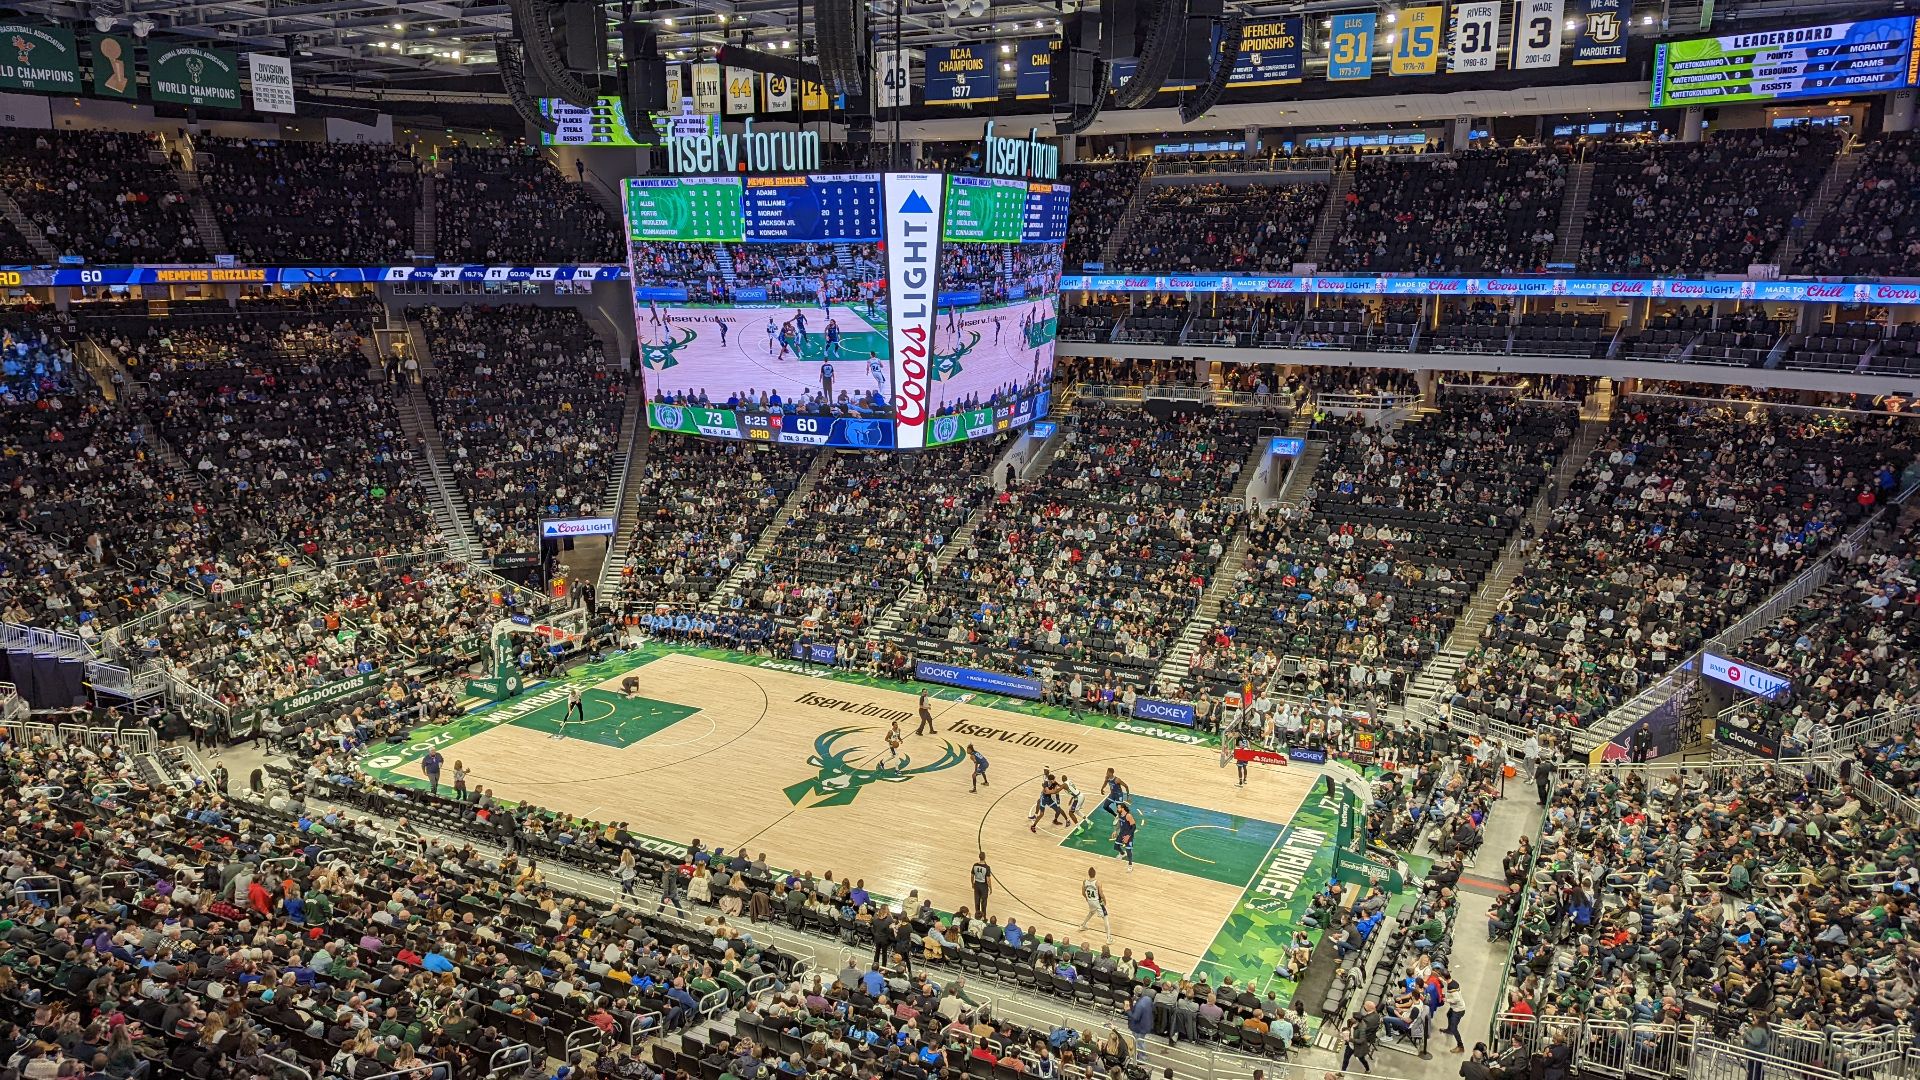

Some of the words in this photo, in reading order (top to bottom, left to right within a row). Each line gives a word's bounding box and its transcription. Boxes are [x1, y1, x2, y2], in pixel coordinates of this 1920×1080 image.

[1532, 3, 1552, 13] WADE
[1590, 0, 1602, 9] WE
[1603, 0, 1619, 8] ARE
[1412, 12, 1425, 21] LEE
[1467, 8, 1492, 18] RIVERS
[1344, 19, 1362, 28] ELLIS
[1461, 22, 1492, 53] 31
[1528, 17, 1551, 48] 3
[1734, 27, 1832, 48] LEADERBOARD
[33, 29, 67, 53] ASSOCIATION
[1398, 26, 1433, 58] 15
[950, 48, 972, 59] NCAA
[1335, 32, 1367, 64] 31
[1580, 45, 1621, 56] MARQUETTE
[1850, 42, 1890, 53] MORANT
[177, 48, 203, 57] BASKETBALL
[203, 51, 230, 73] ASSOCIATION
[1525, 54, 1551, 63] 2001-03
[1767, 51, 1793, 60] POINTS
[258, 63, 284, 73] DIVISION
[939, 59, 983, 72] CHAMPIONS
[1851, 59, 1884, 68] ADAMS
[17, 66, 74, 83] CHAMPIONS
[1759, 66, 1797, 76] REBOUNDS
[255, 72, 290, 85] CHAMPIONS
[1846, 74, 1885, 84] MORANT
[157, 81, 187, 94] WORLD
[189, 85, 236, 100] CHAMPIONS
[696, 81, 717, 96] HANK
[729, 77, 751, 98] 44
[772, 79, 785, 93] 24
[951, 86, 971, 98] 1977
[1761, 82, 1791, 91] ASSISTS
[666, 117, 819, 173] fiserv.forum
[985, 120, 1058, 180] fiserv.forum
[759, 219, 785, 227] JACKSON
[157, 270, 208, 281] MEMPHIS
[211, 269, 265, 281] GRIZZLIES
[392, 270, 404, 278] FG
[440, 270, 455, 278] 3PT
[491, 270, 502, 278] FT
[536, 270, 551, 278] FLS
[903, 219, 928, 319] LIGHT
[81, 270, 102, 282] 60
[1124, 278, 1149, 288] Chill
[1169, 277, 1194, 288] Coors
[1267, 279, 1293, 289] Chill
[1317, 279, 1345, 289] Coors
[1428, 280, 1460, 291] Chill
[1487, 280, 1518, 291] Coors
[1611, 281, 1645, 293] Chill
[1671, 281, 1704, 294] Coors
[1806, 285, 1846, 298] Chill
[1877, 286, 1918, 299] Coors
[896, 323, 927, 428] Coors
[1020, 401, 1029, 414] 60
[705, 411, 722, 425] 73
[744, 415, 768, 426] 8:25
[974, 412, 985, 426] 73
[796, 418, 818, 432] 60
[750, 429, 770, 439] 3RD
[558, 522, 585, 533] Coors
[586, 523, 611, 532] LIGHT
[505, 556, 526, 564] clover
[883, 635, 905, 643] verizon
[917, 640, 940, 649] verizon
[797, 646, 834, 660] JCKEY
[953, 645, 975, 653] verizon
[991, 651, 1015, 660] verizon
[1073, 665, 1098, 674] verizon
[1709, 663, 1726, 674] BMO
[920, 667, 959, 680] JOCKEY
[1007, 682, 1034, 691] COLLECTION
[1114, 671, 1139, 681] verizon
[282, 677, 364, 711] 1-800-DOCTORS
[794, 691, 914, 723] fiserv.forum
[1141, 704, 1187, 719] JOCKEY
[947, 719, 1079, 755] fiserv.forum
[1115, 722, 1208, 745] betway
[1729, 732, 1757, 748] clover
[1290, 750, 1323, 761] JOCKEY
[1341, 802, 1350, 828] betway
[1256, 826, 1328, 899] MILWAUKEE
[1087, 890, 1096, 899] 24
